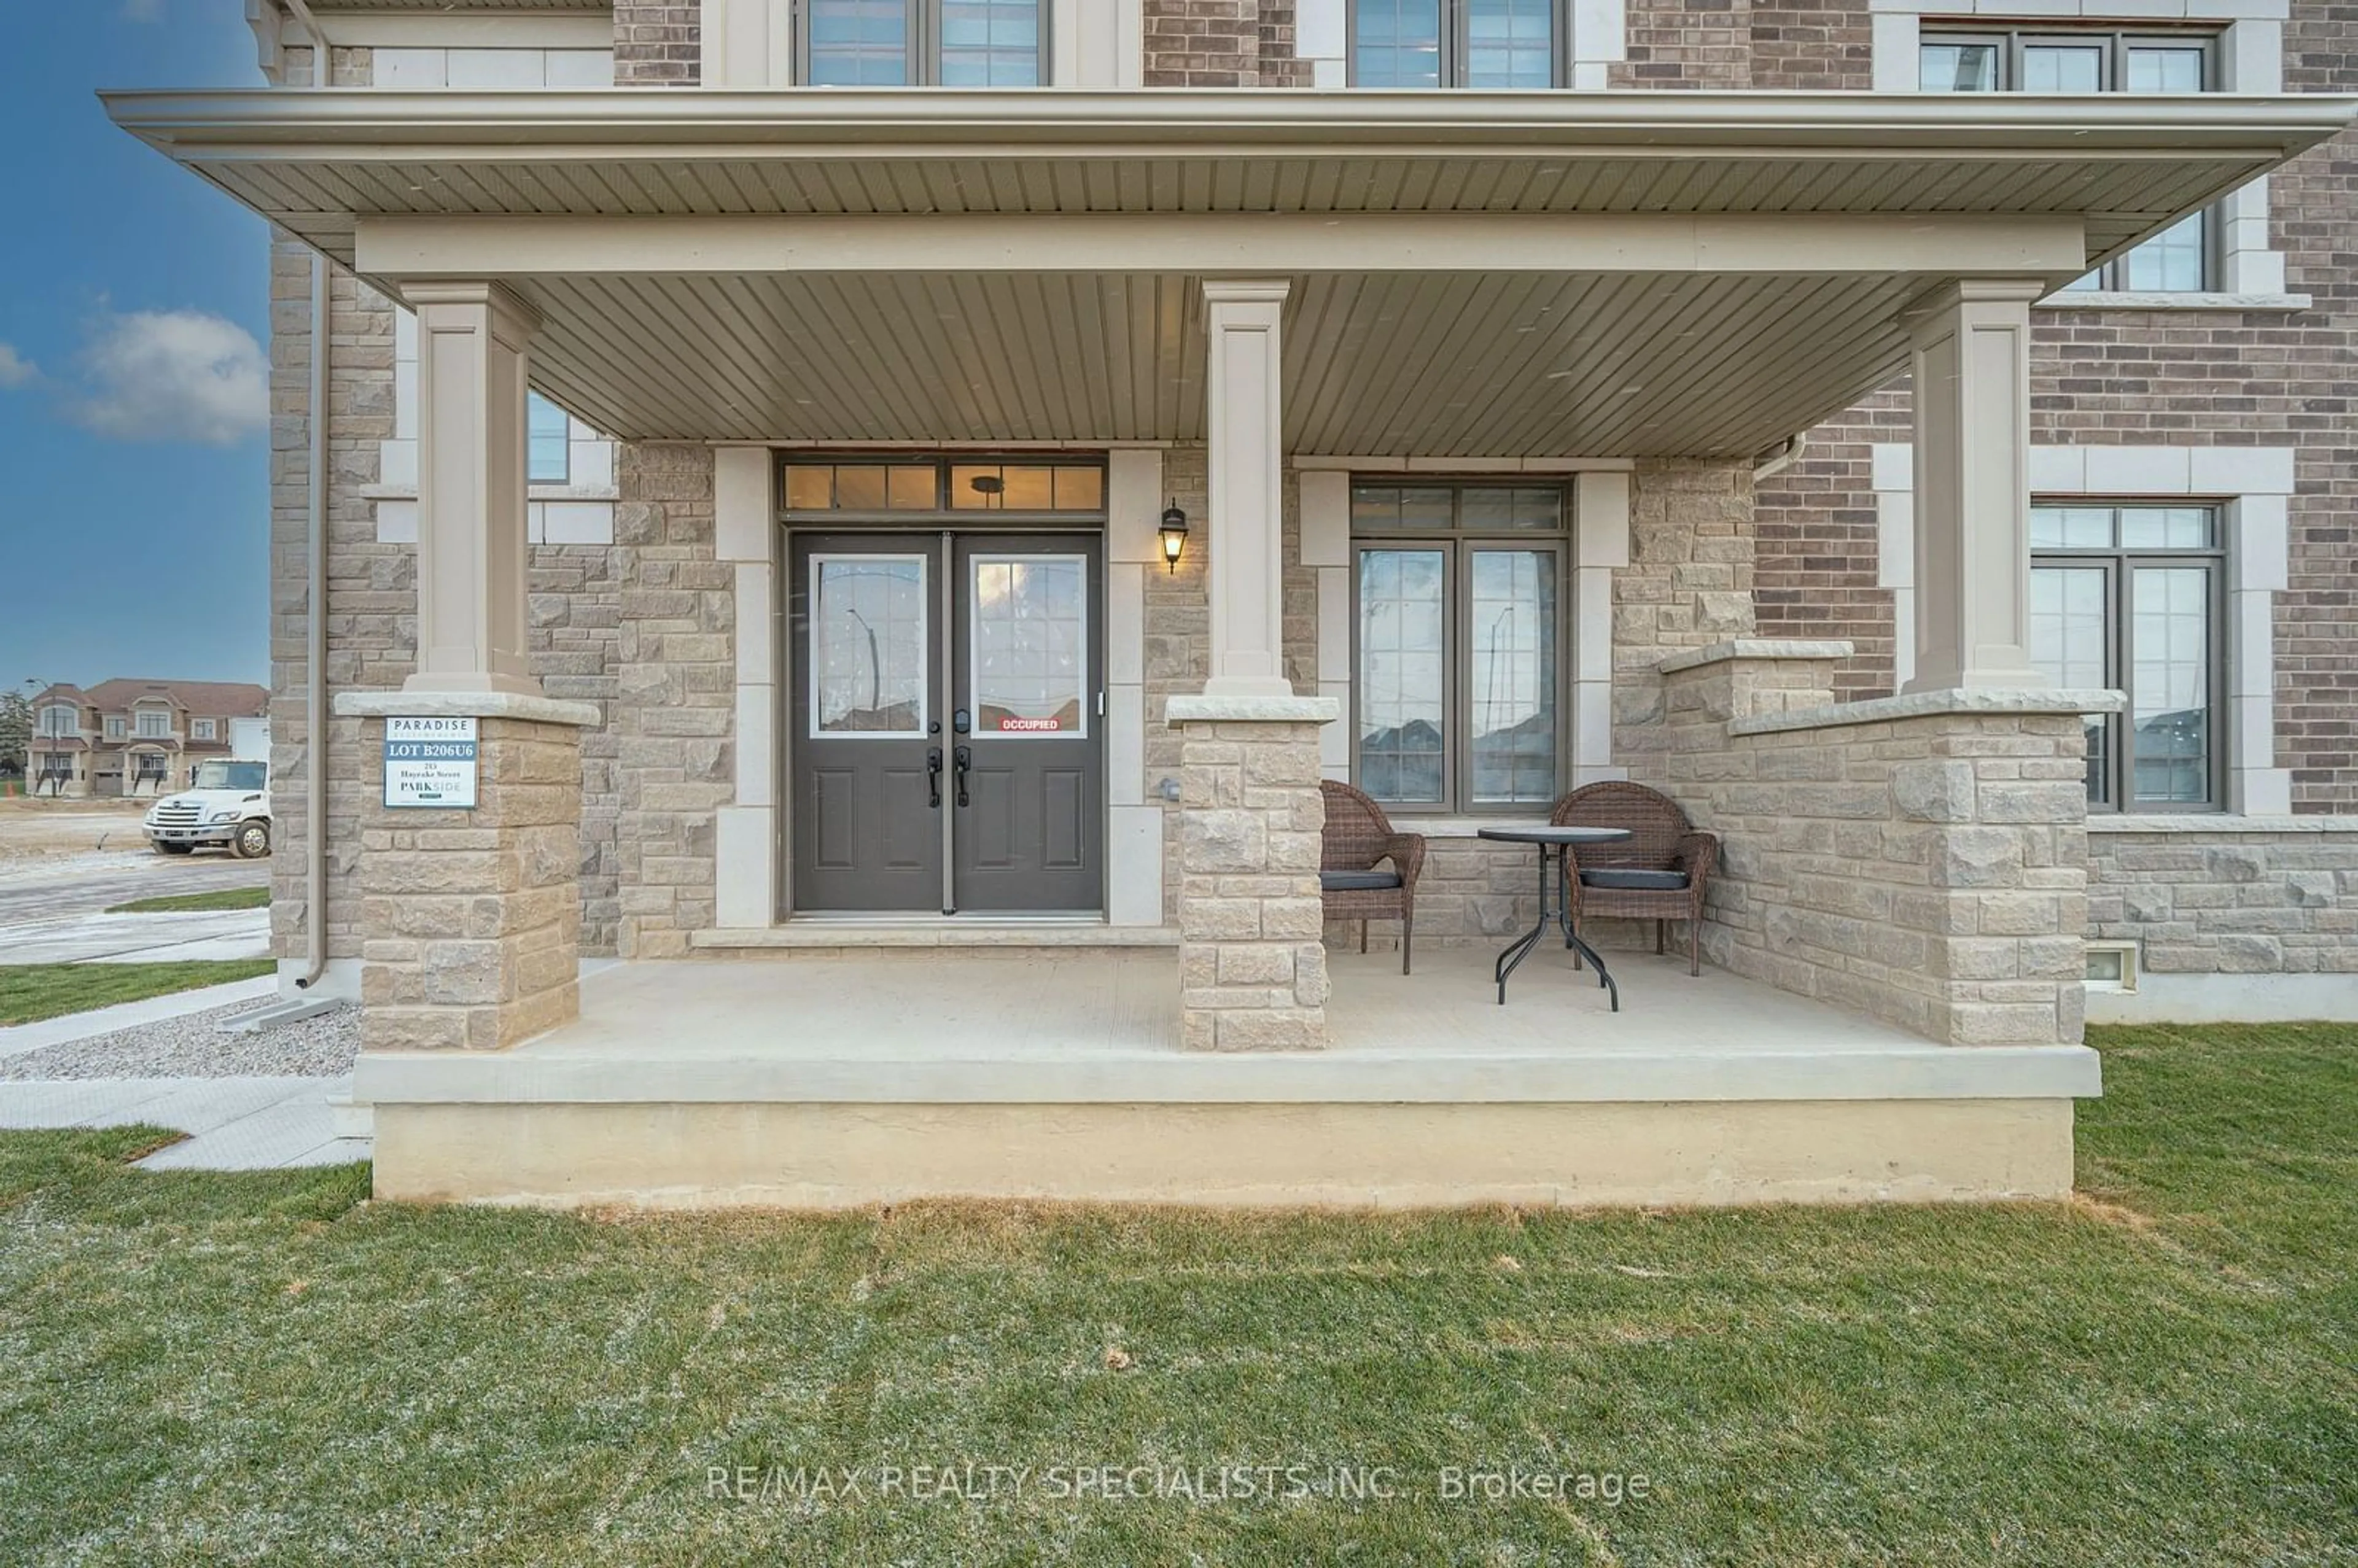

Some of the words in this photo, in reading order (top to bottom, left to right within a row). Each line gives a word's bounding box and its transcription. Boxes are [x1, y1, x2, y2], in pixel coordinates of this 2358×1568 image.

[395, 721, 467, 730] PARADISE
[1003, 720, 1057, 729] OCCUPIED
[389, 745, 420, 756] LOT
[424, 745, 473, 756] B206U6
